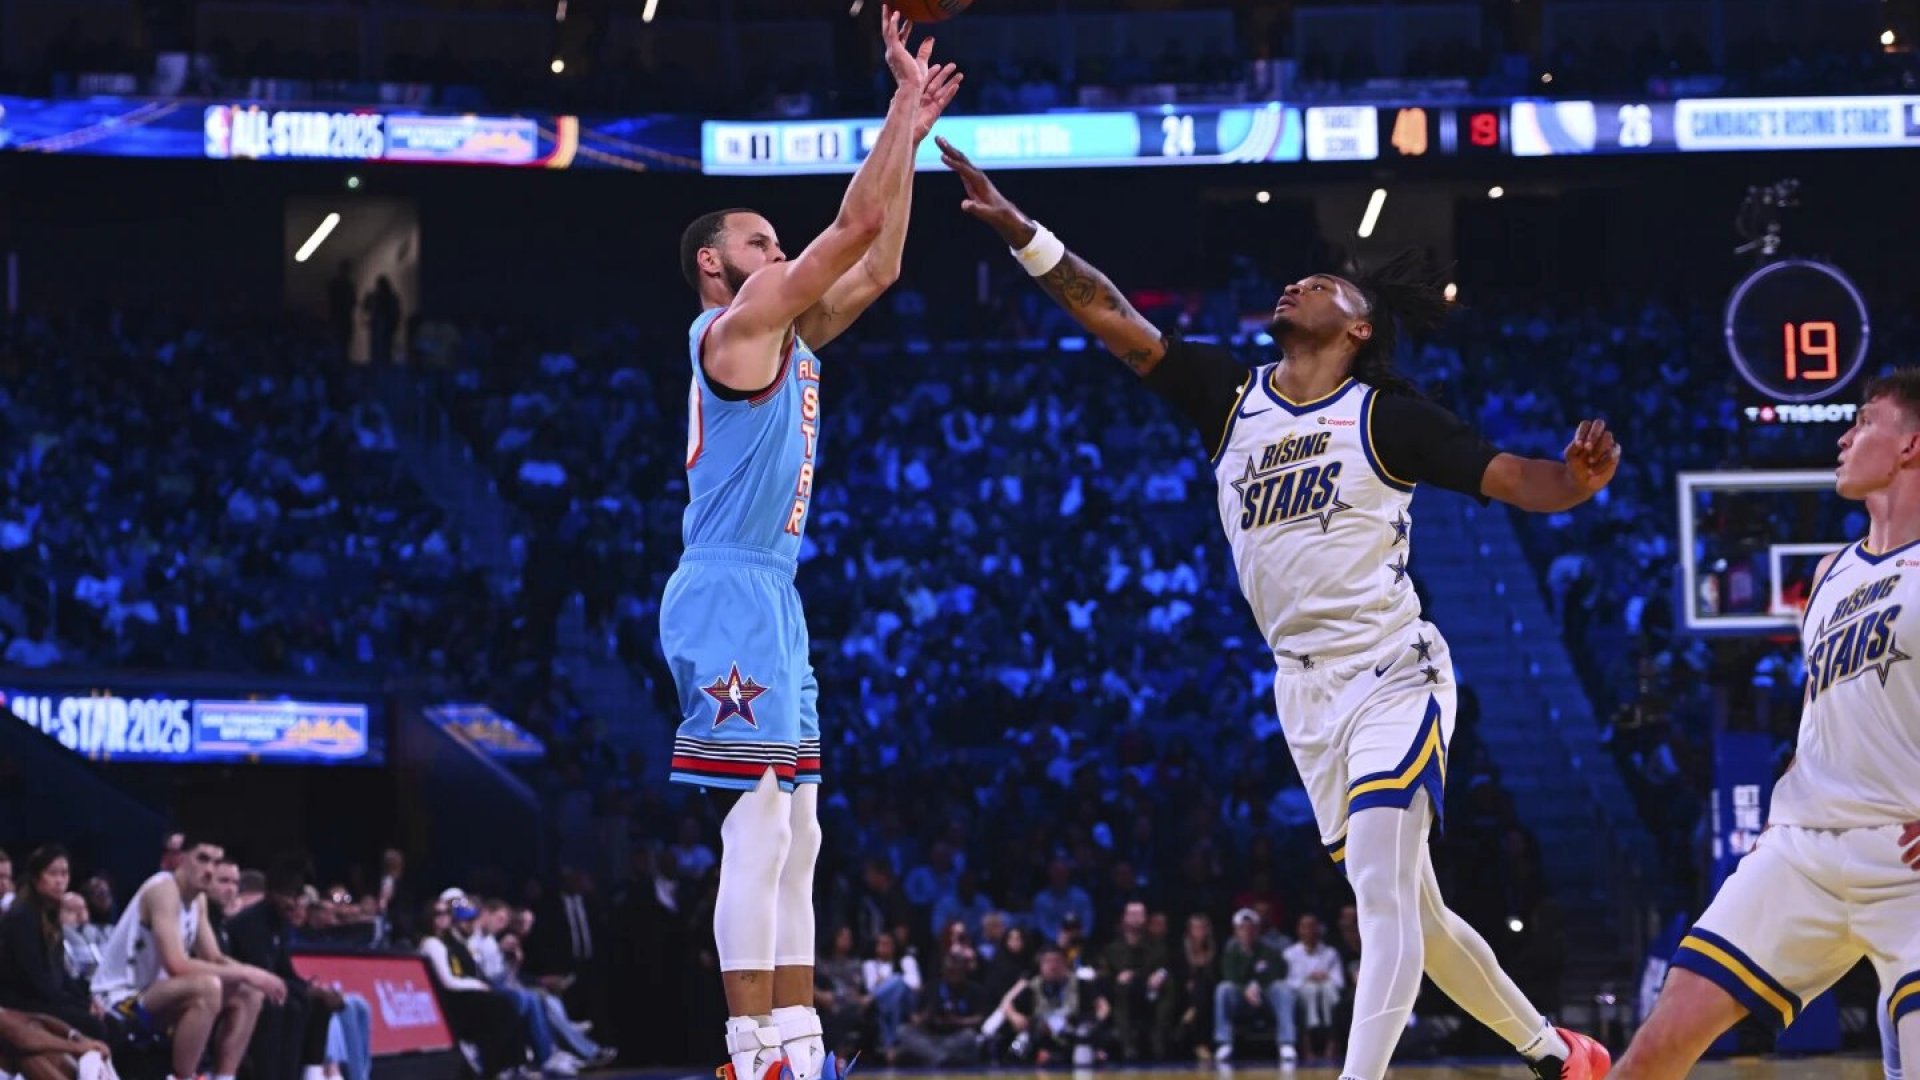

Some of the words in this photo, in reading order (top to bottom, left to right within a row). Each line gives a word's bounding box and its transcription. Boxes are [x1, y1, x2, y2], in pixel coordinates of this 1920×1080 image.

[1783, 321, 1838, 381] 19
[1775, 404, 1857, 422] TISSOT
[1259, 431, 1333, 471] RISING
[1241, 460, 1344, 531] STARS
[1810, 603, 1903, 704] STARS
